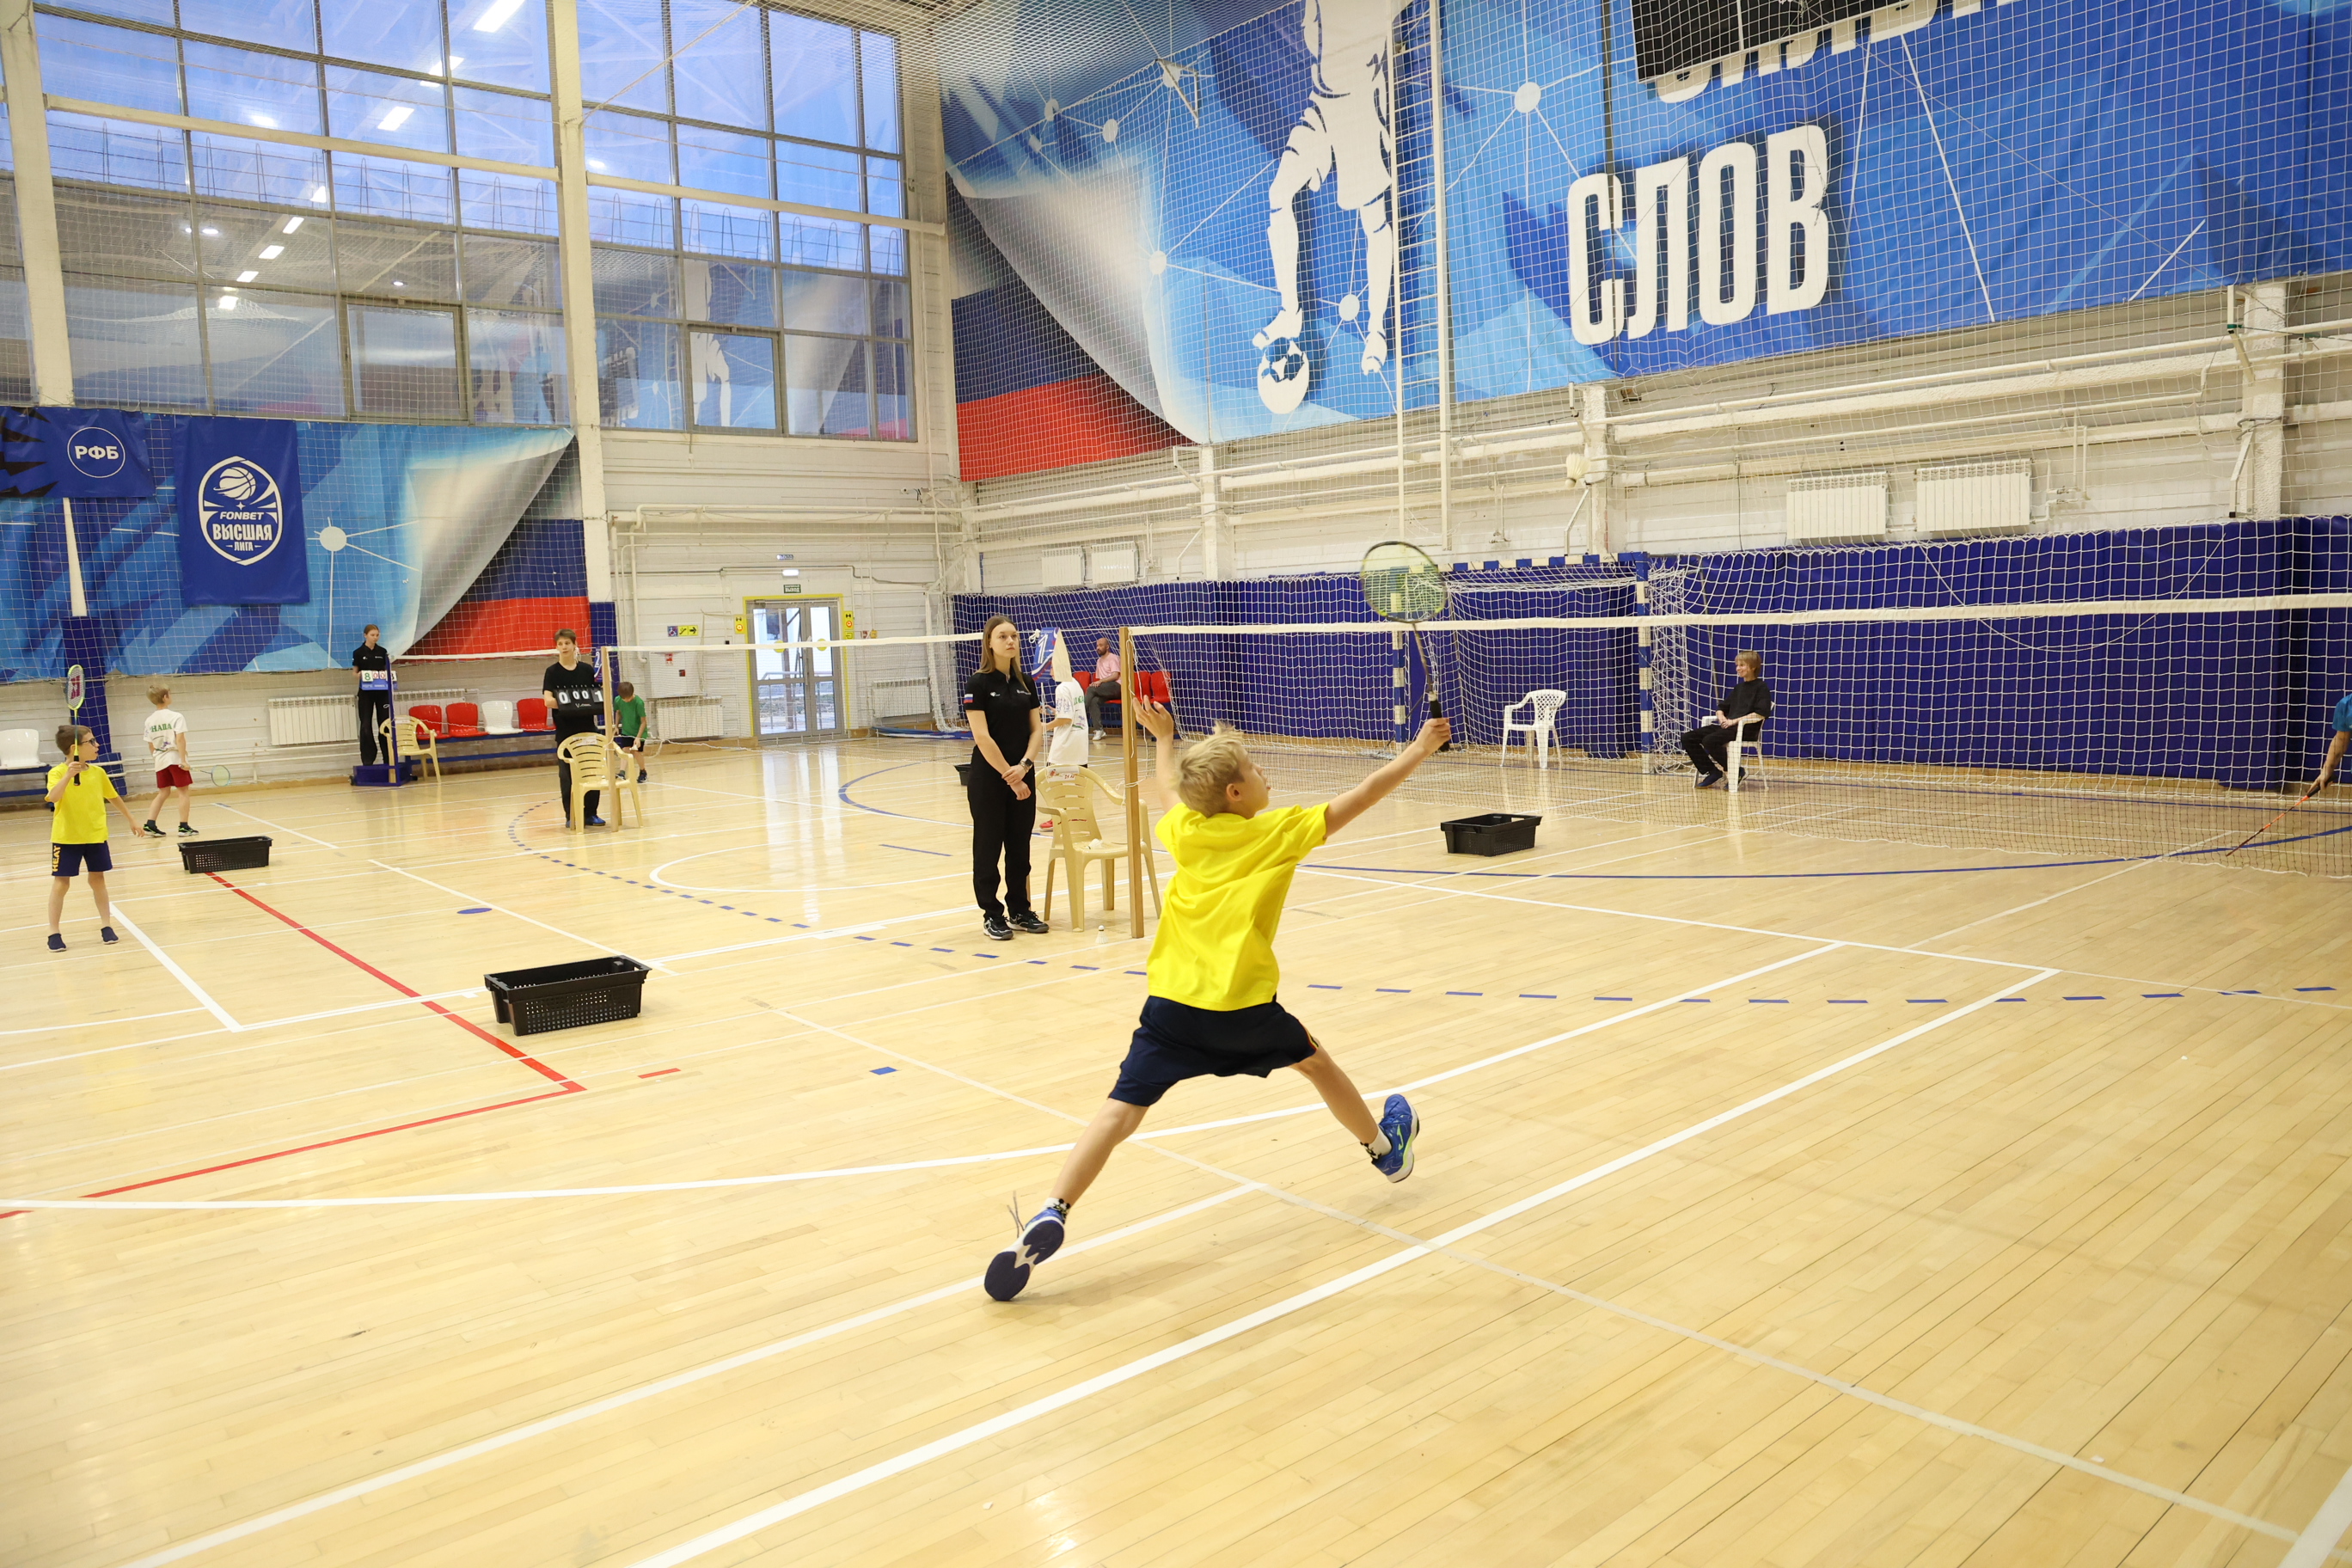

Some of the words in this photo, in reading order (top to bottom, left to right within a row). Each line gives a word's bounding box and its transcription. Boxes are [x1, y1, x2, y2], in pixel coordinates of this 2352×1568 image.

[1567, 124, 1828, 346] СЛОВ
[74, 445, 119, 460] РФБ
[219, 511, 265, 521] FONBET
[212, 523, 273, 541] ВЫСШАЯ
[234, 541, 254, 552] ЛИГА
[1038, 634, 1048, 664] 1
[364, 672, 371, 681] 8
[559, 691, 568, 704] 0
